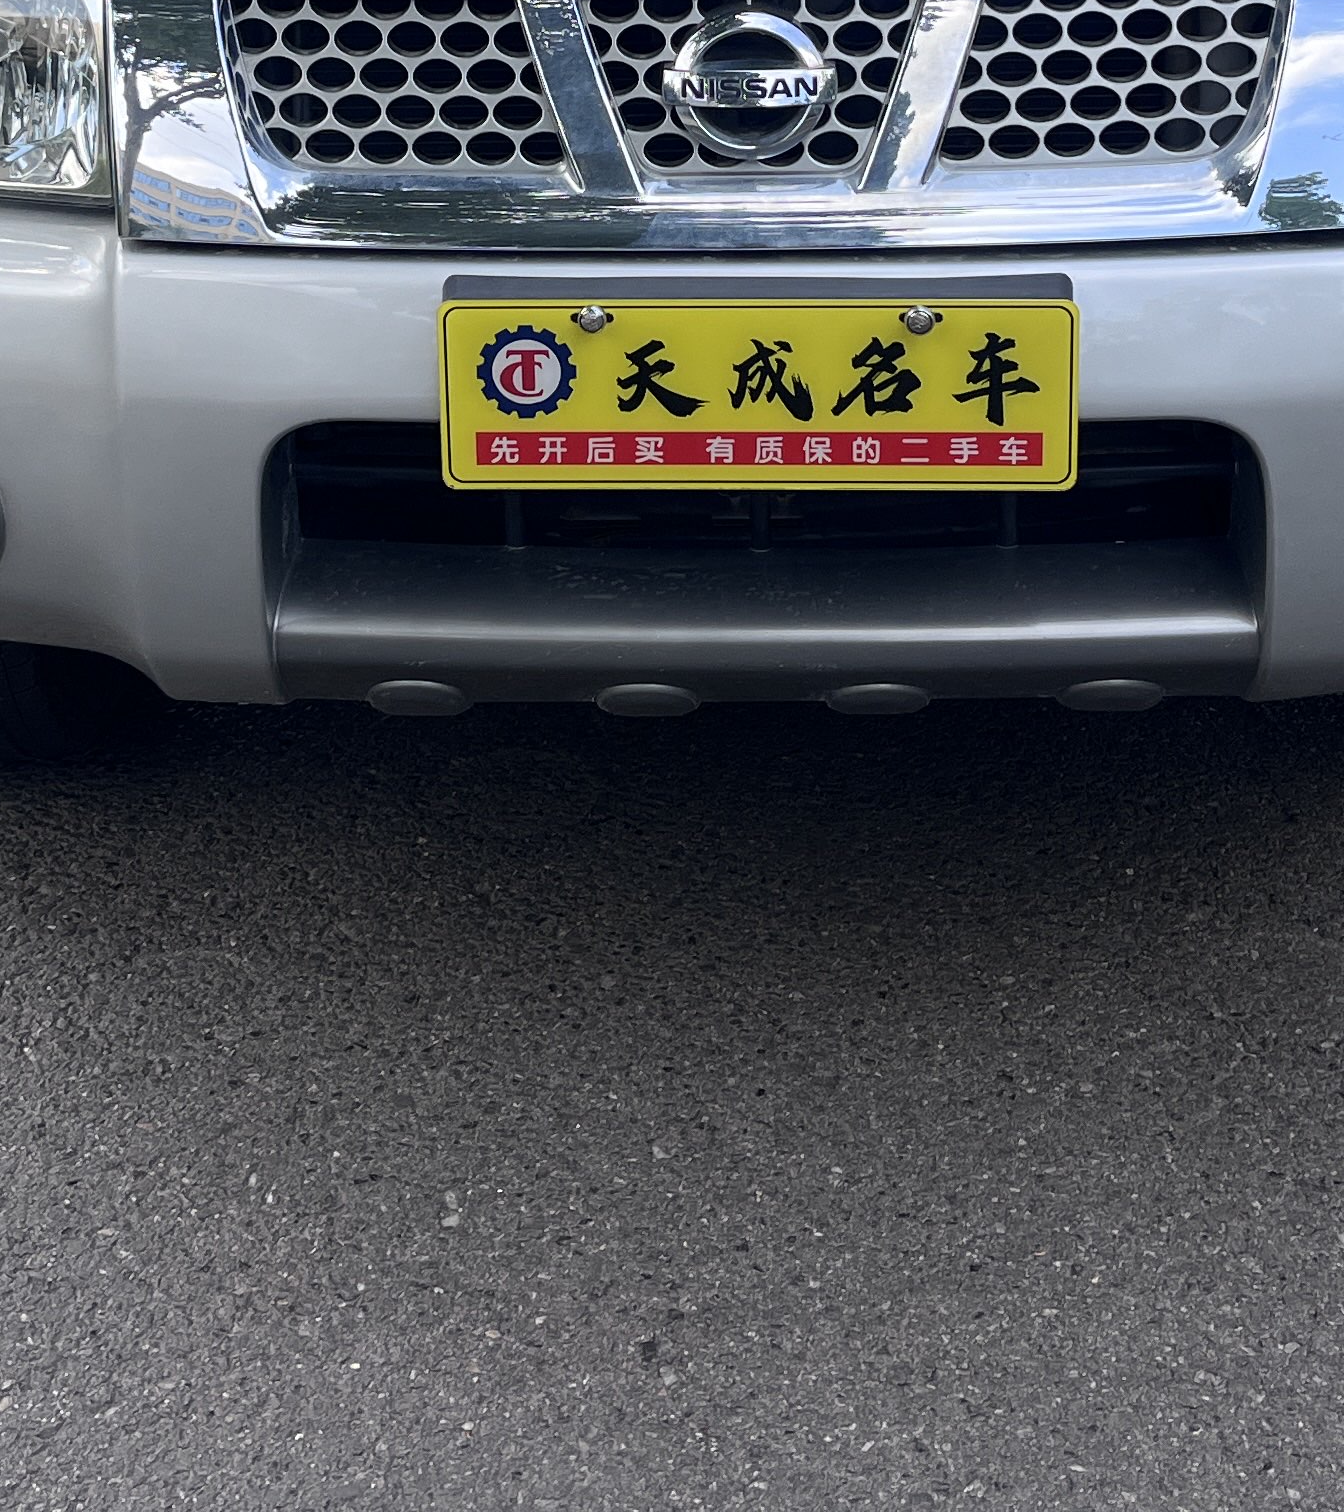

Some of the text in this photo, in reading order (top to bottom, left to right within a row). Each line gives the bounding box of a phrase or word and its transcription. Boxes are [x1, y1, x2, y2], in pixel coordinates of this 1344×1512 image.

[681, 75, 818, 99] NISSAN
[616, 332, 1041, 426] 天成名车
[490, 436, 1029, 465] 先开后买 有质保的二手车
